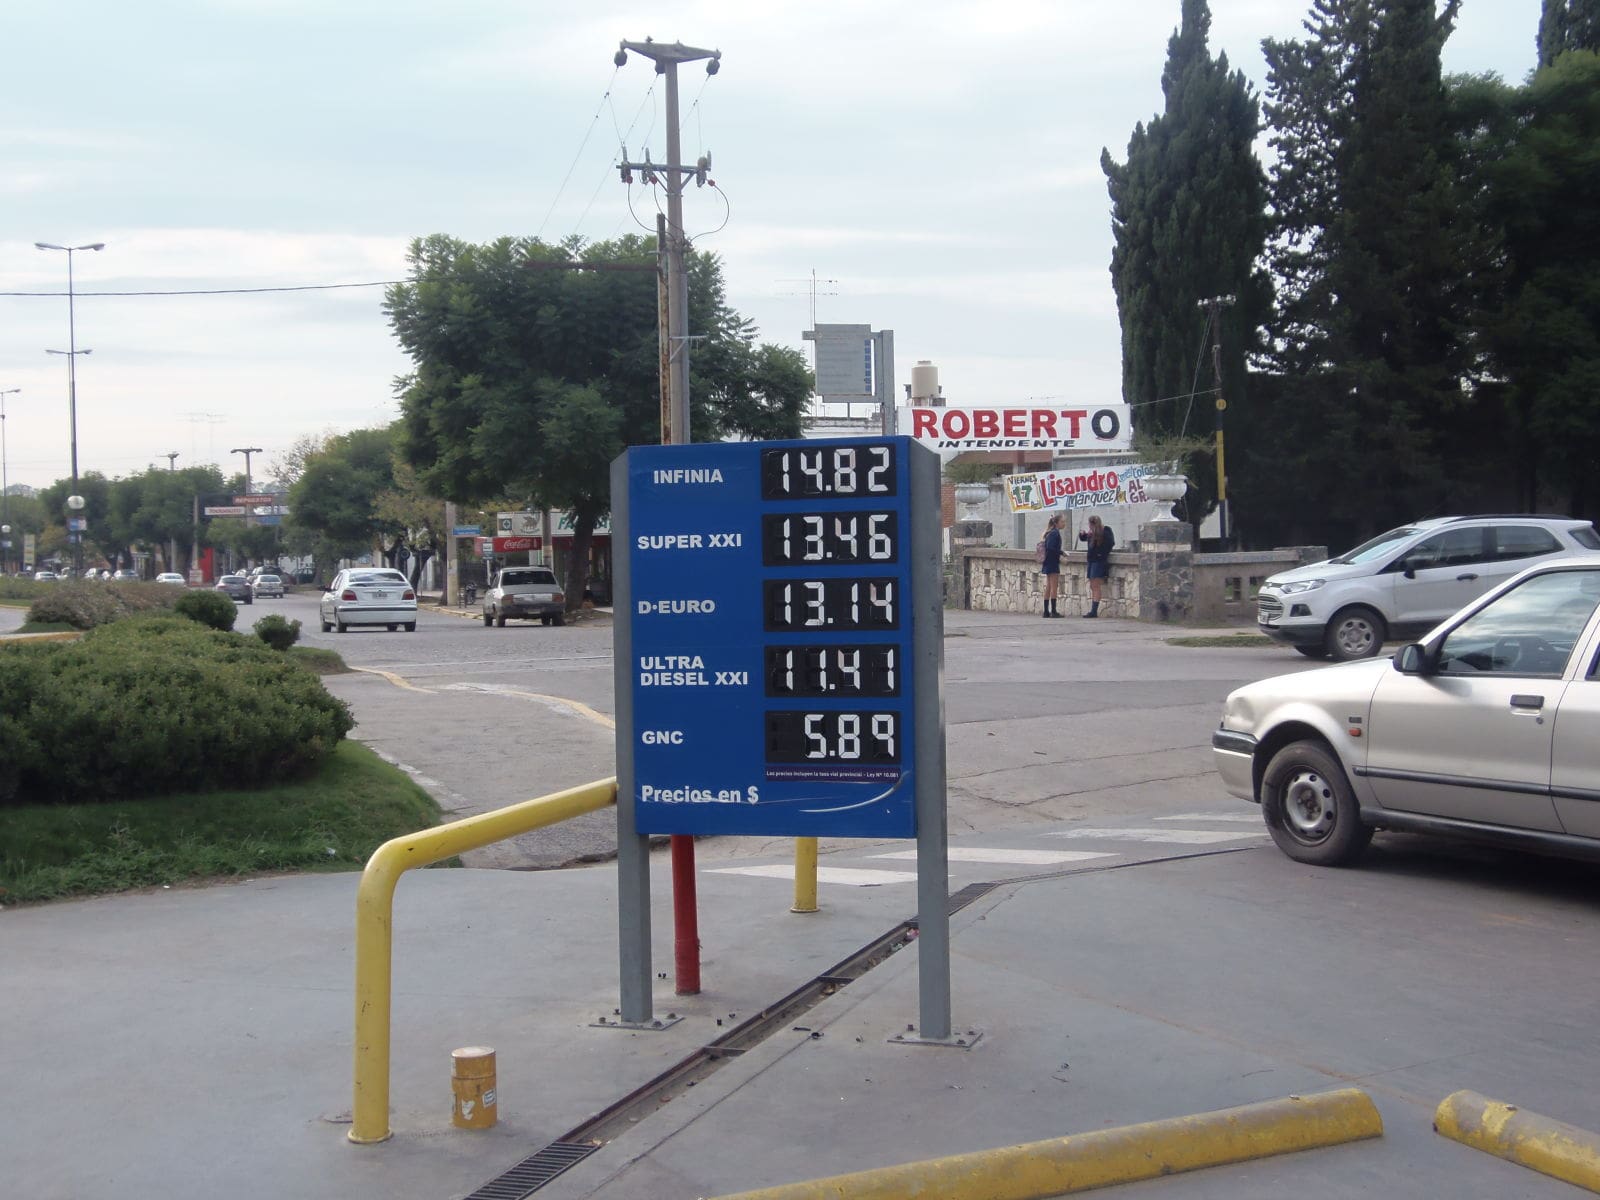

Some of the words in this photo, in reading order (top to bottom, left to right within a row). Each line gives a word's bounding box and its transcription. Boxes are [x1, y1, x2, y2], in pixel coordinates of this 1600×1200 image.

[912, 409, 1120, 439] ROBERTO
[938, 439, 1075, 448] INTENDENTE
[653, 468, 724, 484] INFINIA
[782, 447, 890, 493] 14.82
[1013, 485, 1033, 504] 17
[1040, 470, 1119, 506] Lisandro
[637, 534, 703, 550] SUPER
[708, 533, 742, 548] XXI
[783, 514, 891, 561] 13.46
[784, 581, 892, 626] 13.14
[640, 655, 705, 670] ULTRA
[786, 649, 894, 692] 11.41
[640, 672, 709, 686] DIESEL
[714, 671, 748, 685] XXI
[641, 730, 684, 745] GNC
[804, 714, 894, 759] 5.89
[641, 785, 713, 803] Precios
[717, 791, 741, 804] en
[747, 785, 759, 805] $
